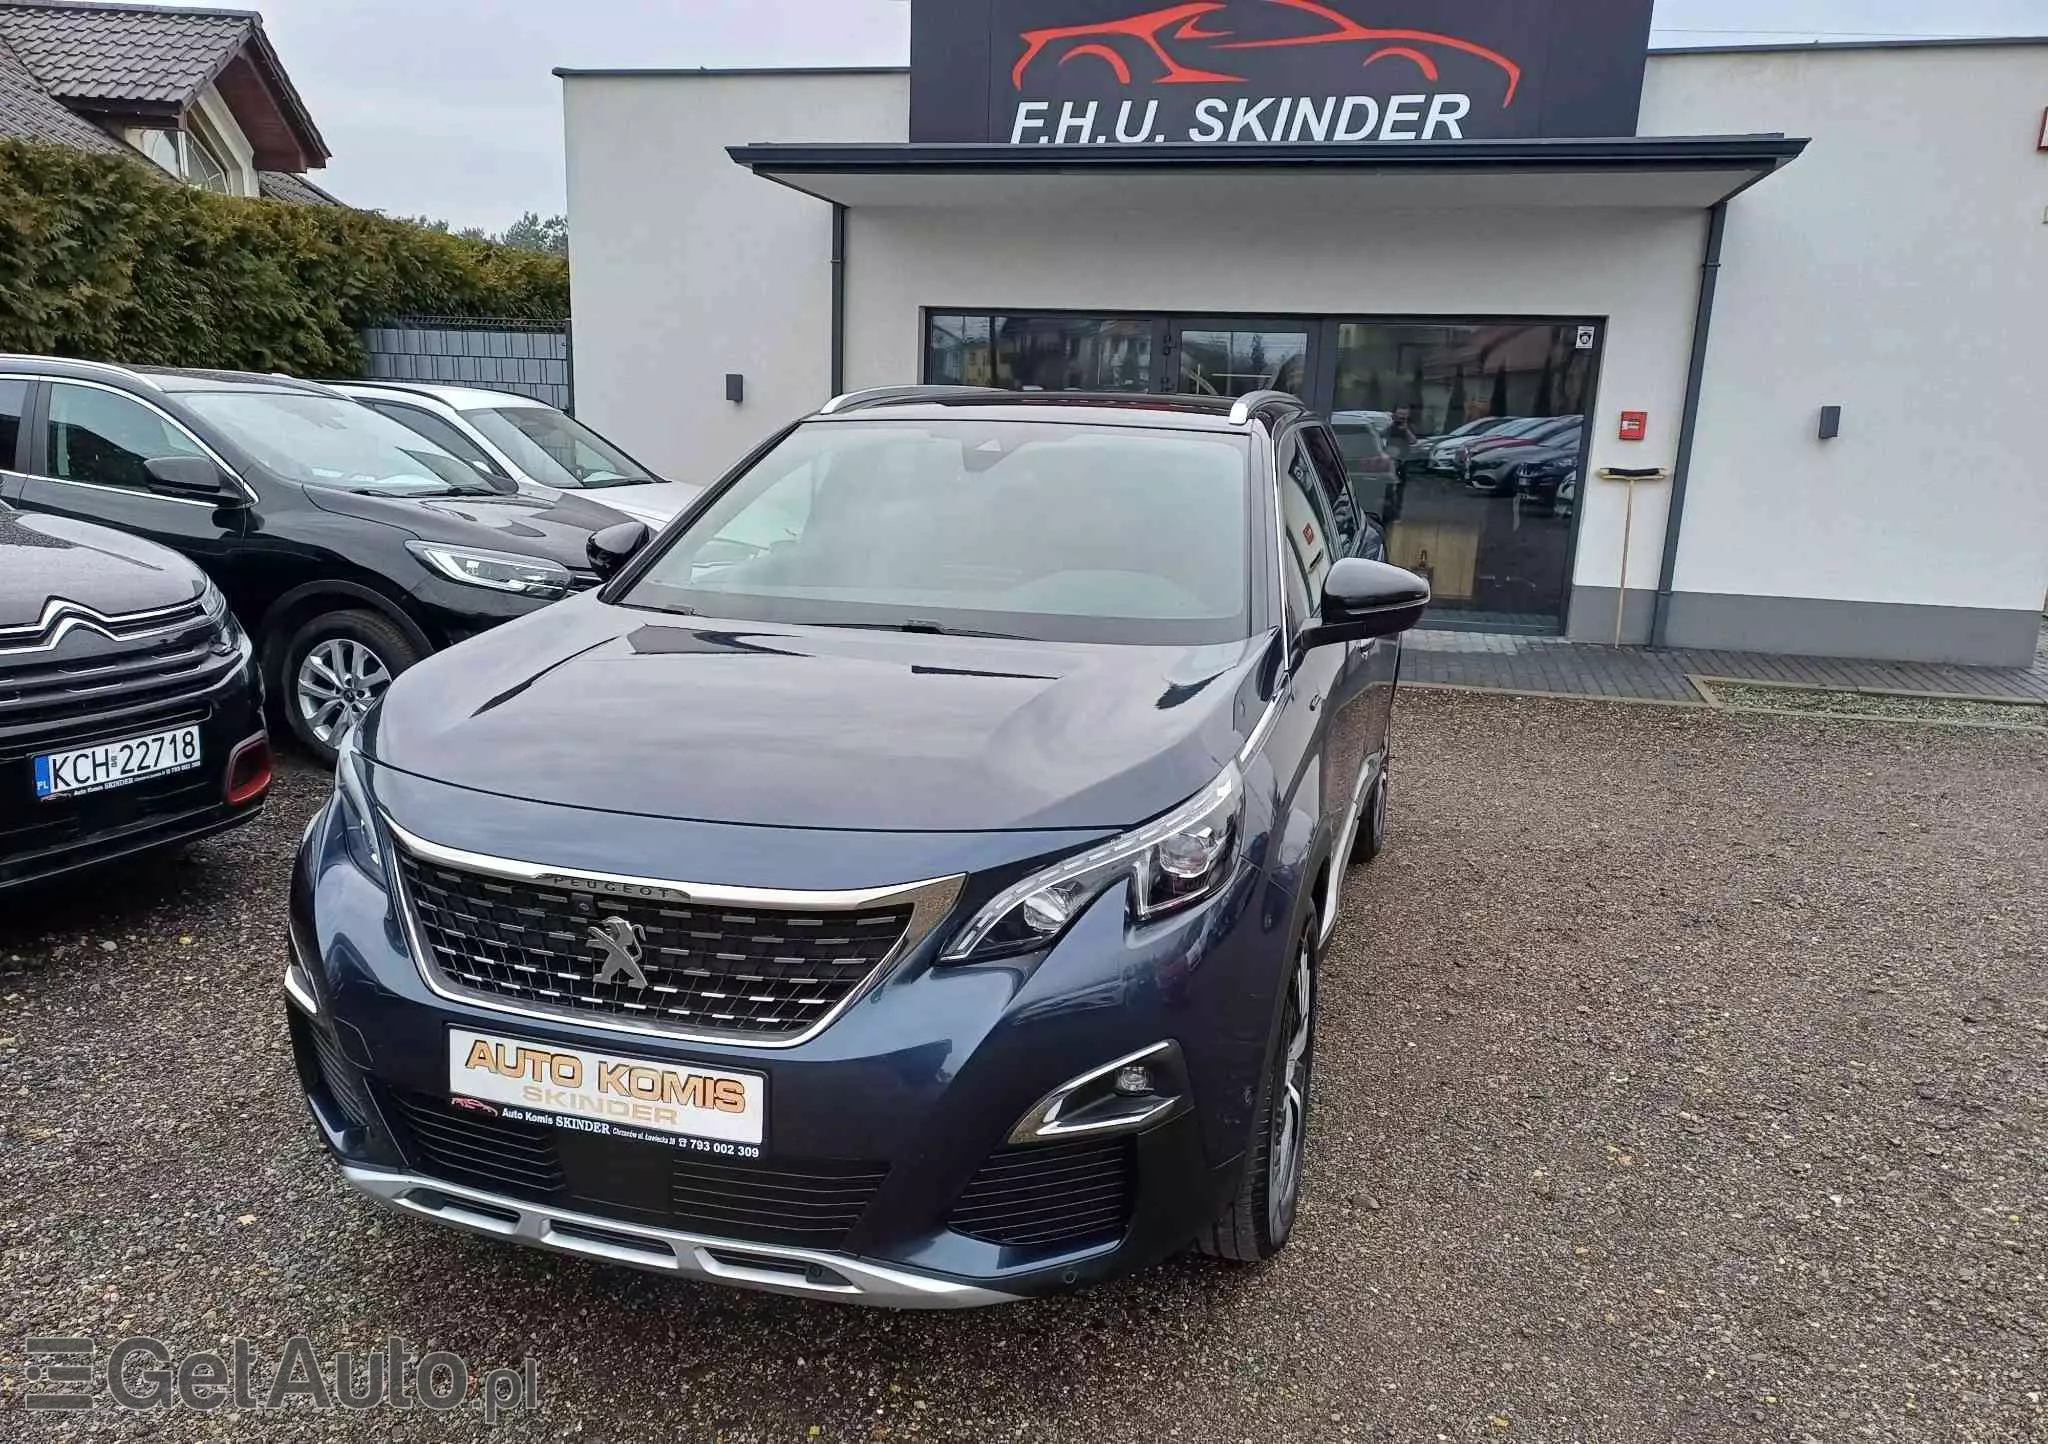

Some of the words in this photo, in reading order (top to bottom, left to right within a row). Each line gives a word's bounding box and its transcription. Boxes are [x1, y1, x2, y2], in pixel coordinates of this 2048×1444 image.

[1010, 99, 1165, 144] F.H.U.
[1189, 93, 1470, 143] SKINDER
[52, 748, 110, 790] KCH
[120, 730, 196, 776] 22718
[36, 780, 48, 790] PL
[554, 877, 669, 898] PEUGEOT
[465, 1039, 583, 1088] AUTO
[598, 1060, 746, 1113] KOMIS
[502, 1108, 523, 1120] Auto
[525, 1111, 553, 1124] Komis
[556, 1116, 610, 1135] SKINDER
[522, 1086, 679, 1126] SKINDER
[690, 1139, 711, 1151] 793
[713, 1142, 735, 1155] 002
[738, 1146, 759, 1158] 309
